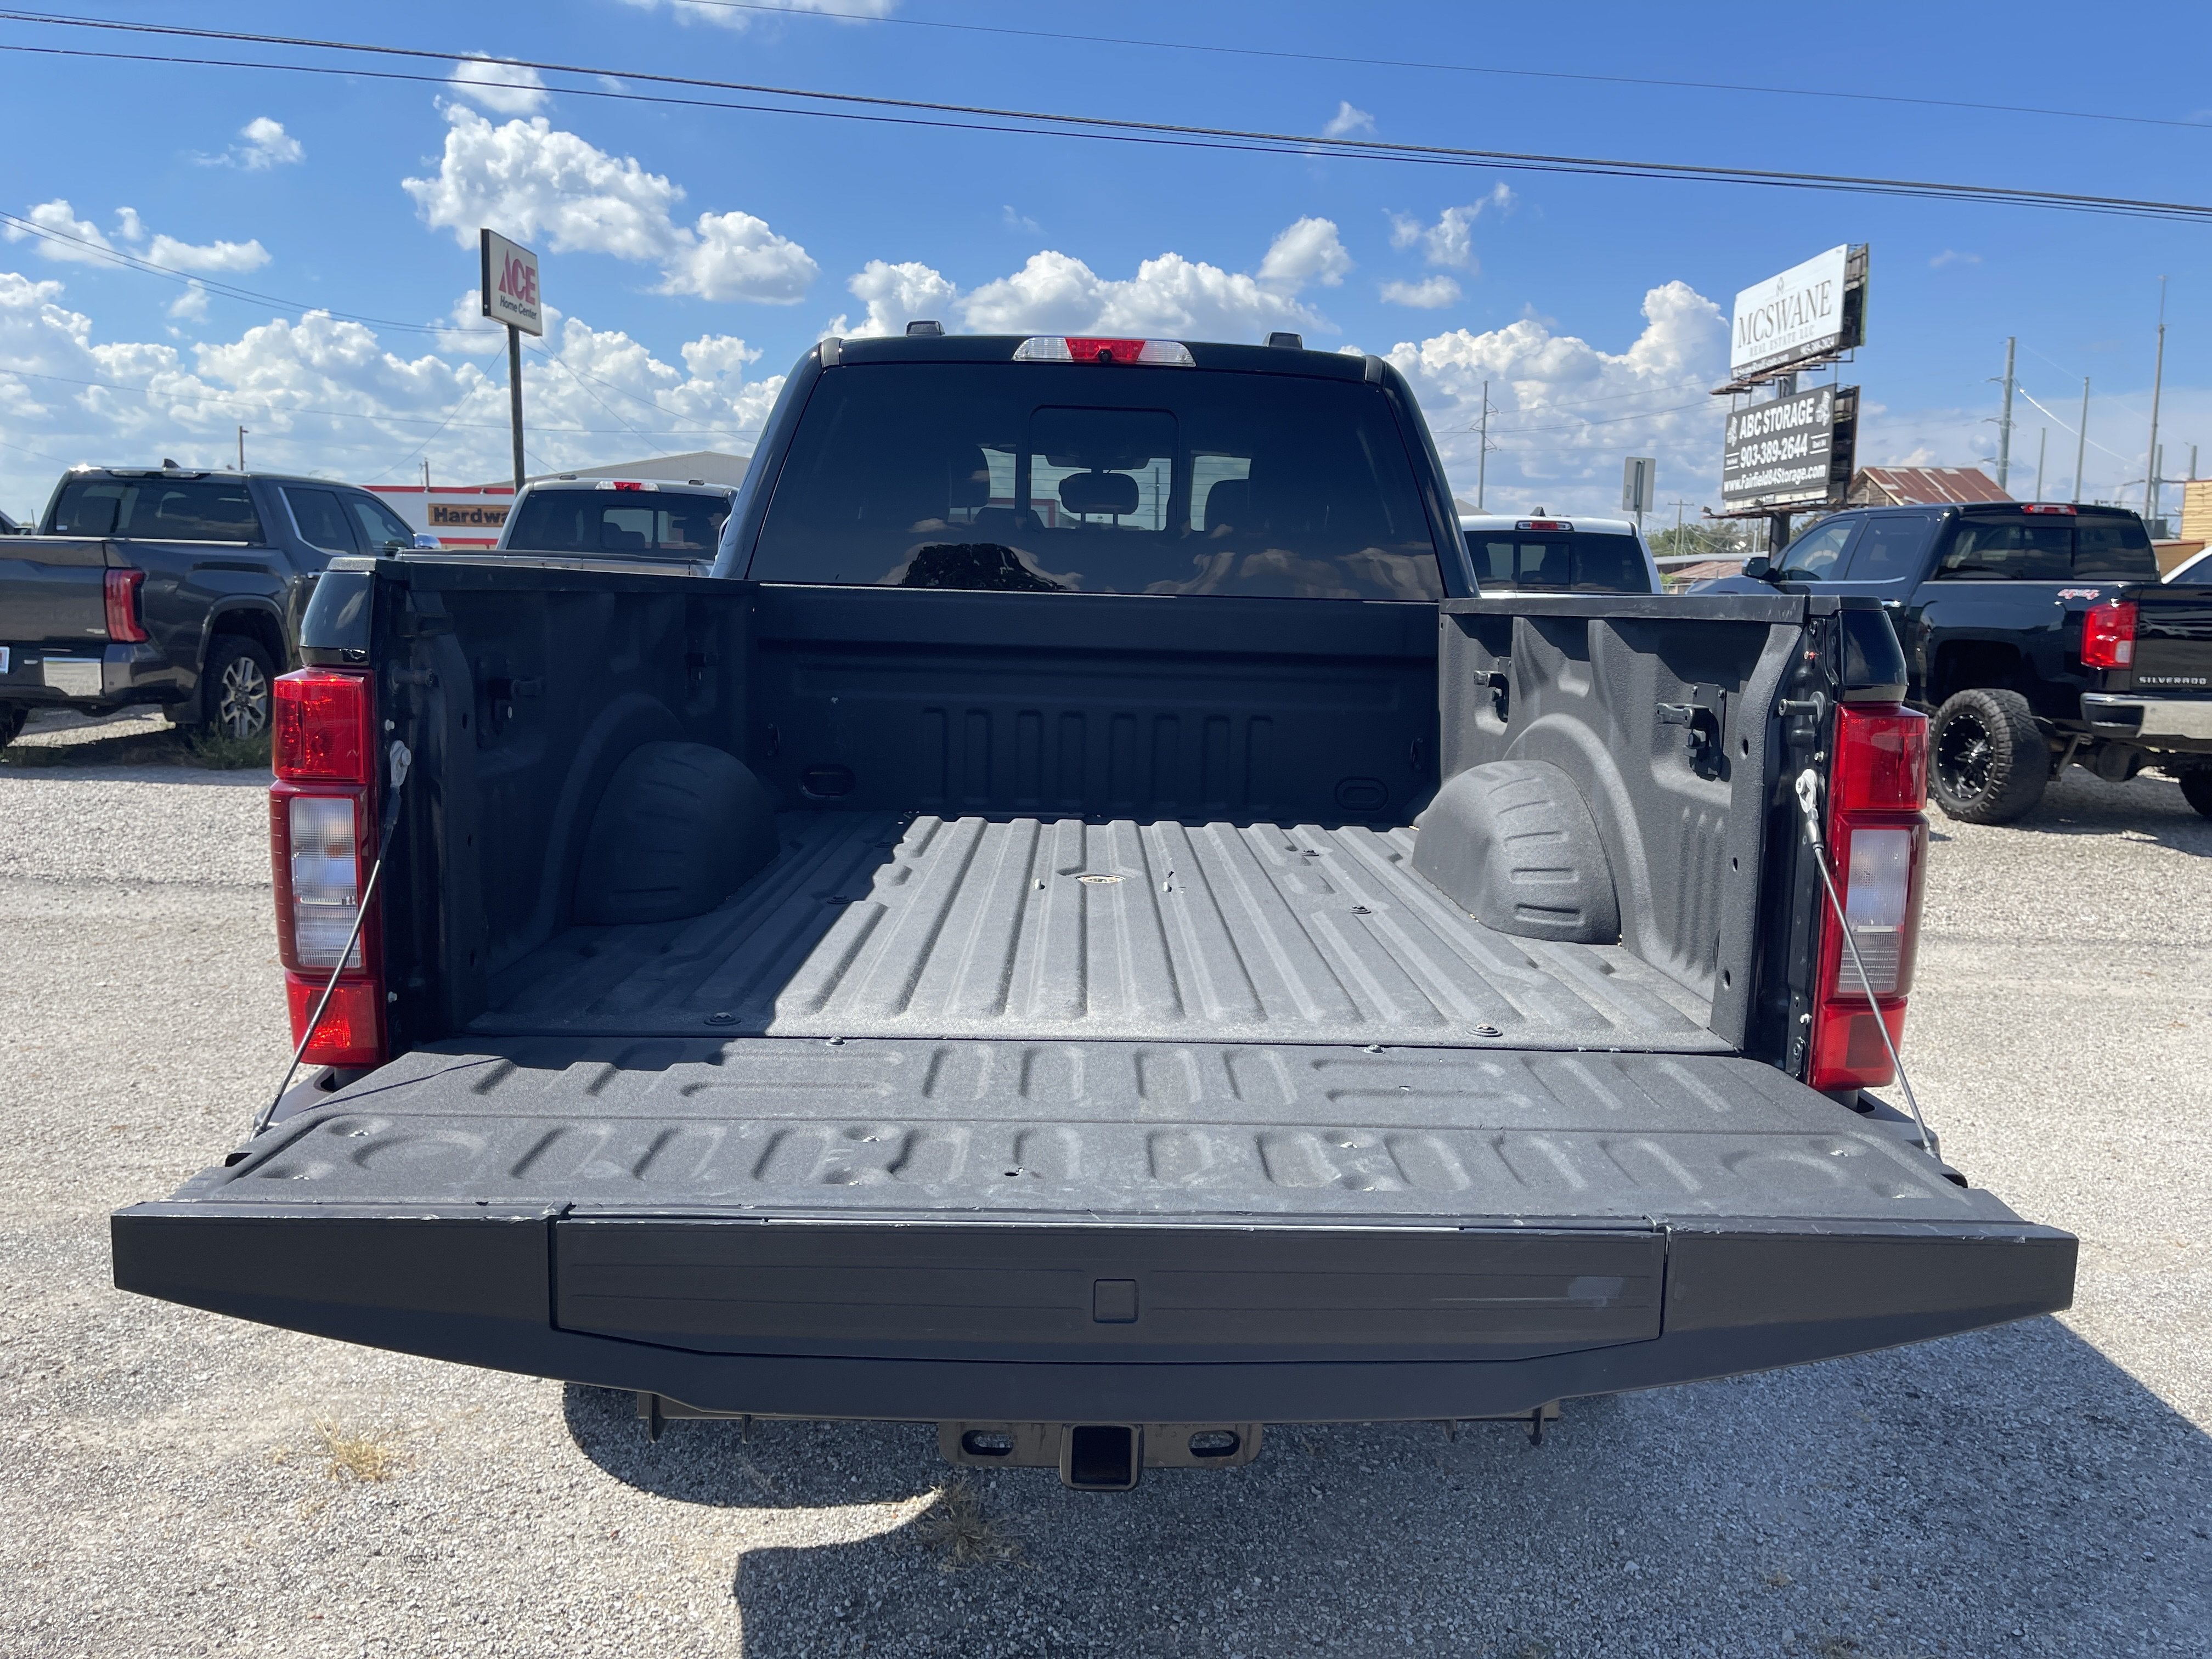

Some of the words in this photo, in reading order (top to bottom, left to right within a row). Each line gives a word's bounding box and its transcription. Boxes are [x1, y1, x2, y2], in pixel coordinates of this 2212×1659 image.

[499, 249, 535, 306] ACE
[500, 295, 517, 312] Home
[518, 303, 537, 319] Center
[1737, 280, 1832, 348] MCSWANE
[1740, 411, 1762, 439] ABC
[1763, 397, 1815, 434] STORAGE
[1740, 433, 1808, 468] 903-389-2644
[2139, 676, 2207, 685] SILVERADO
